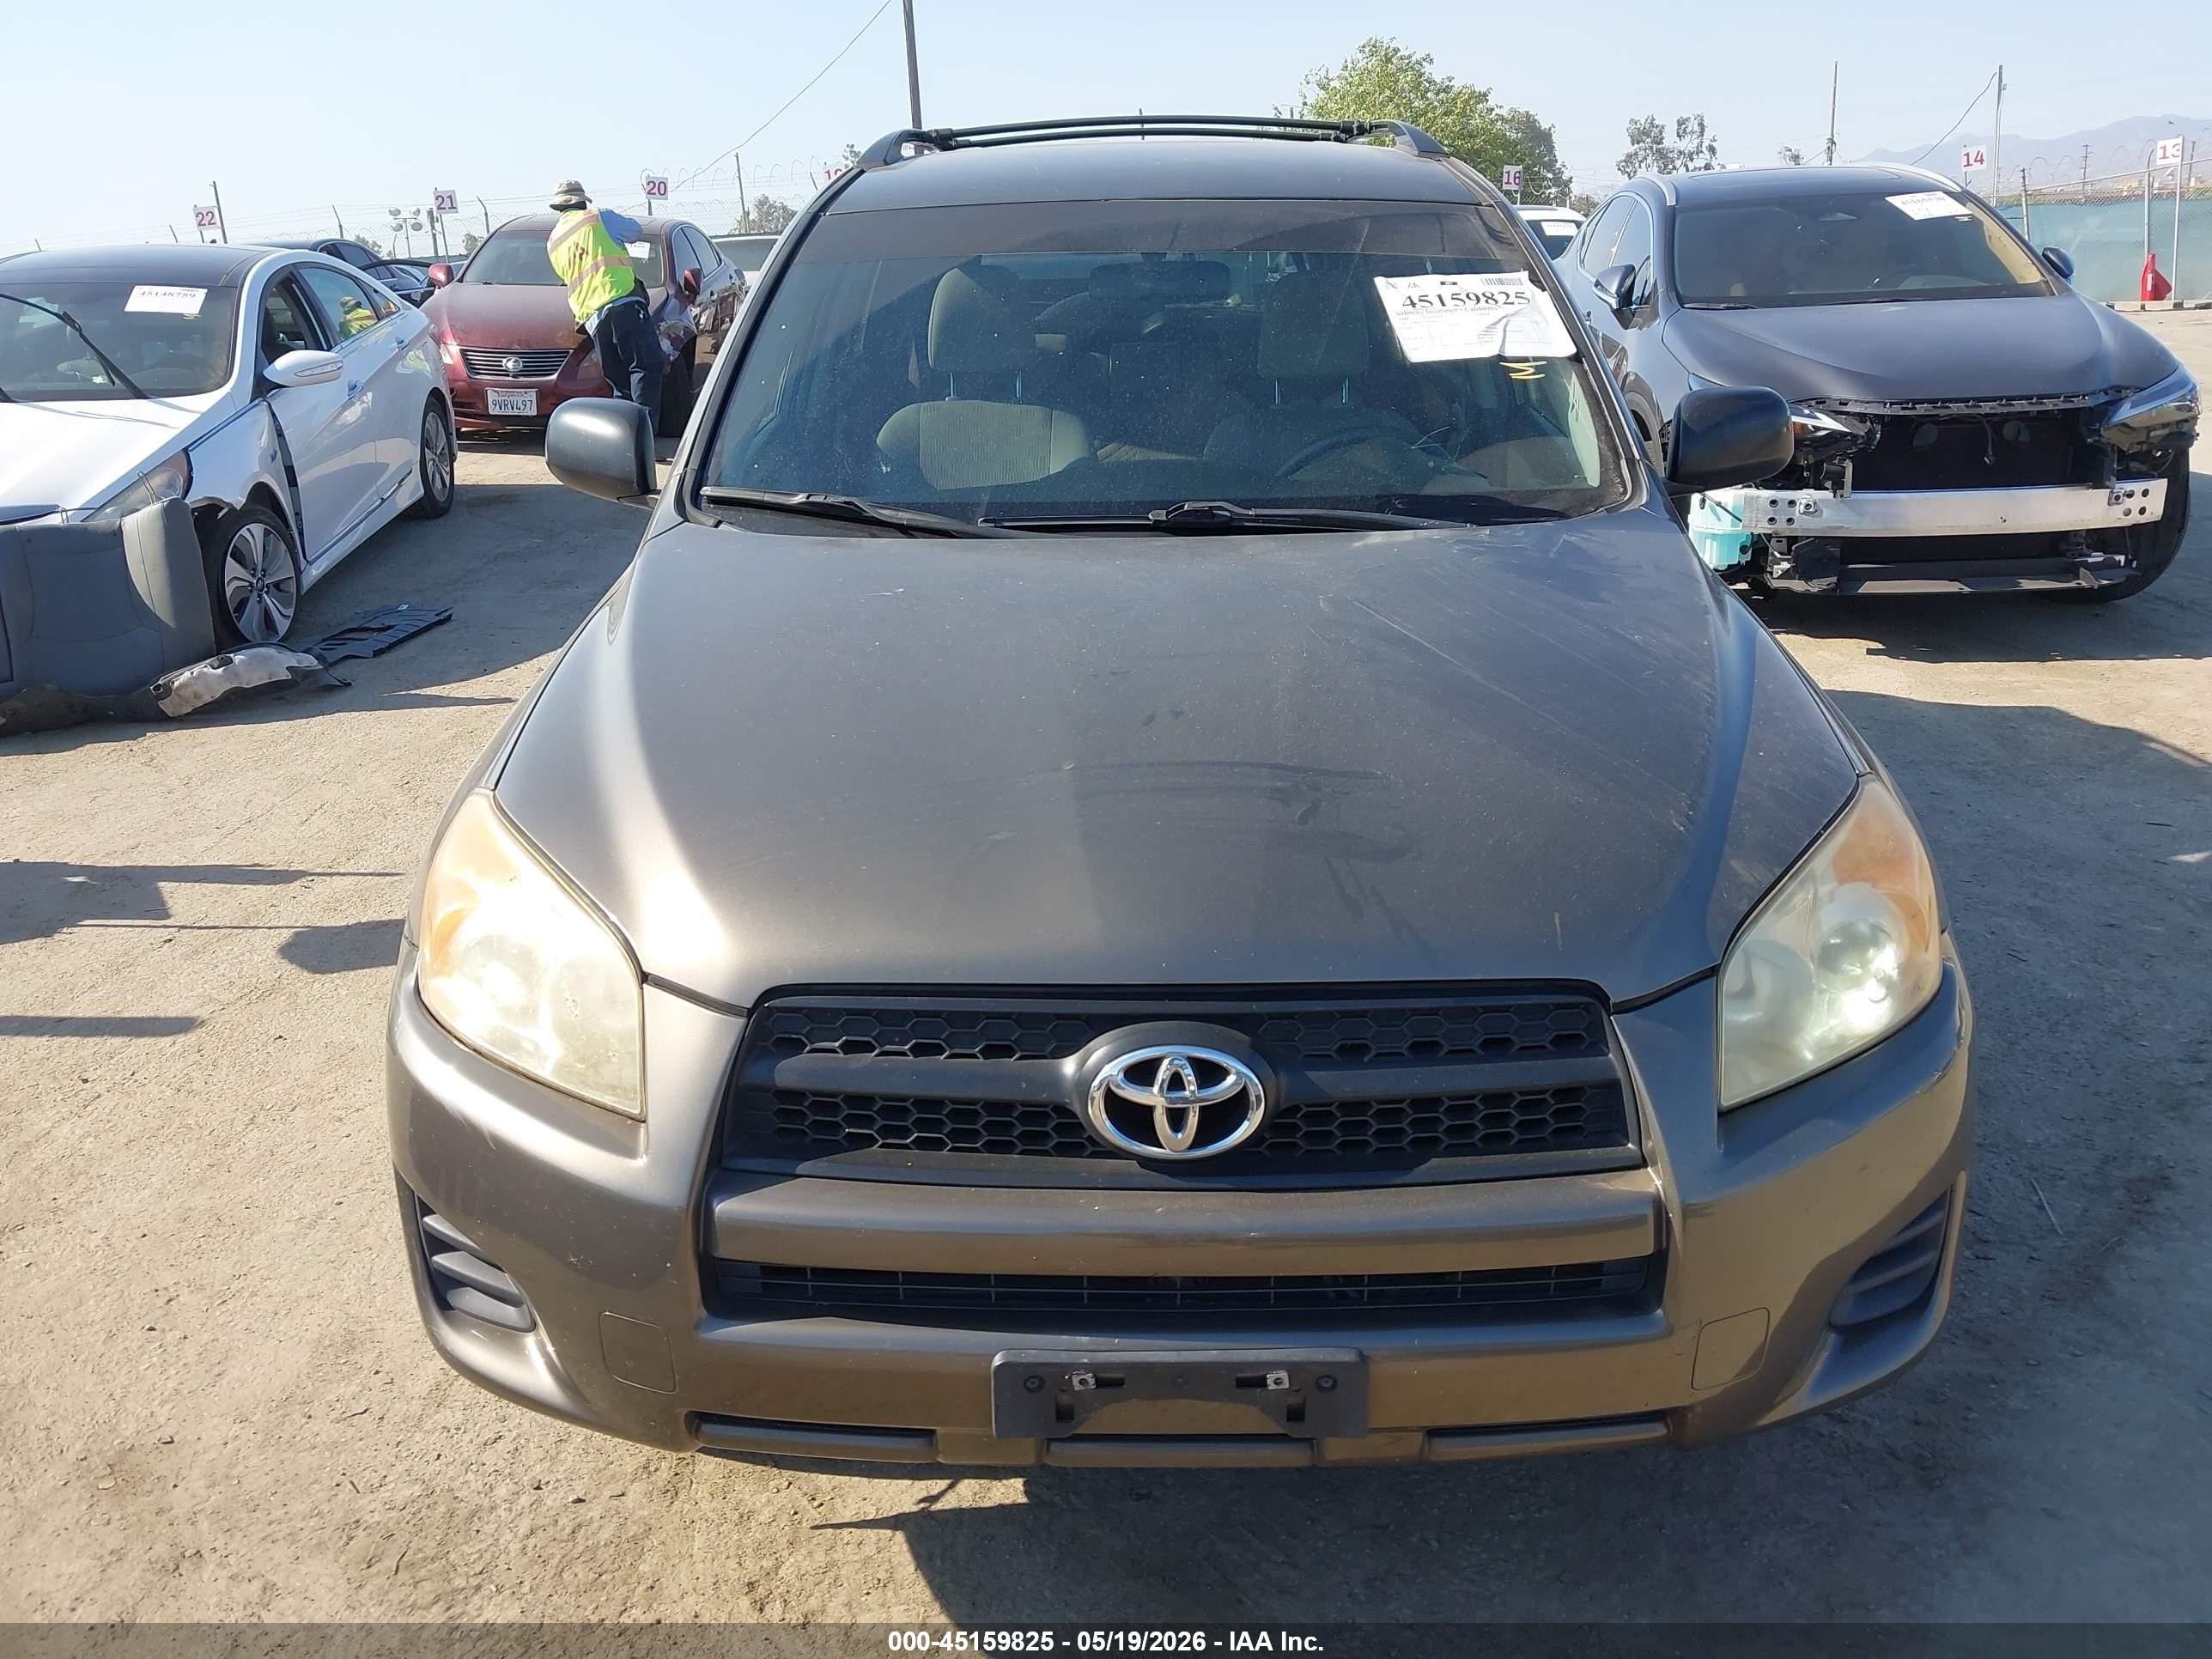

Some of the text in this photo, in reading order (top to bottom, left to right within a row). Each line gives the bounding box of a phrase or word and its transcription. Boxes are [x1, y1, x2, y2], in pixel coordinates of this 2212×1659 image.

[1963, 149, 1984, 167] 14
[1504, 170, 1521, 186] 16
[647, 180, 667, 196] 20
[435, 194, 457, 210] 21
[196, 210, 216, 227] 22
[1402, 291, 1531, 308] 45159825
[491, 398, 533, 412] 9VRV497
